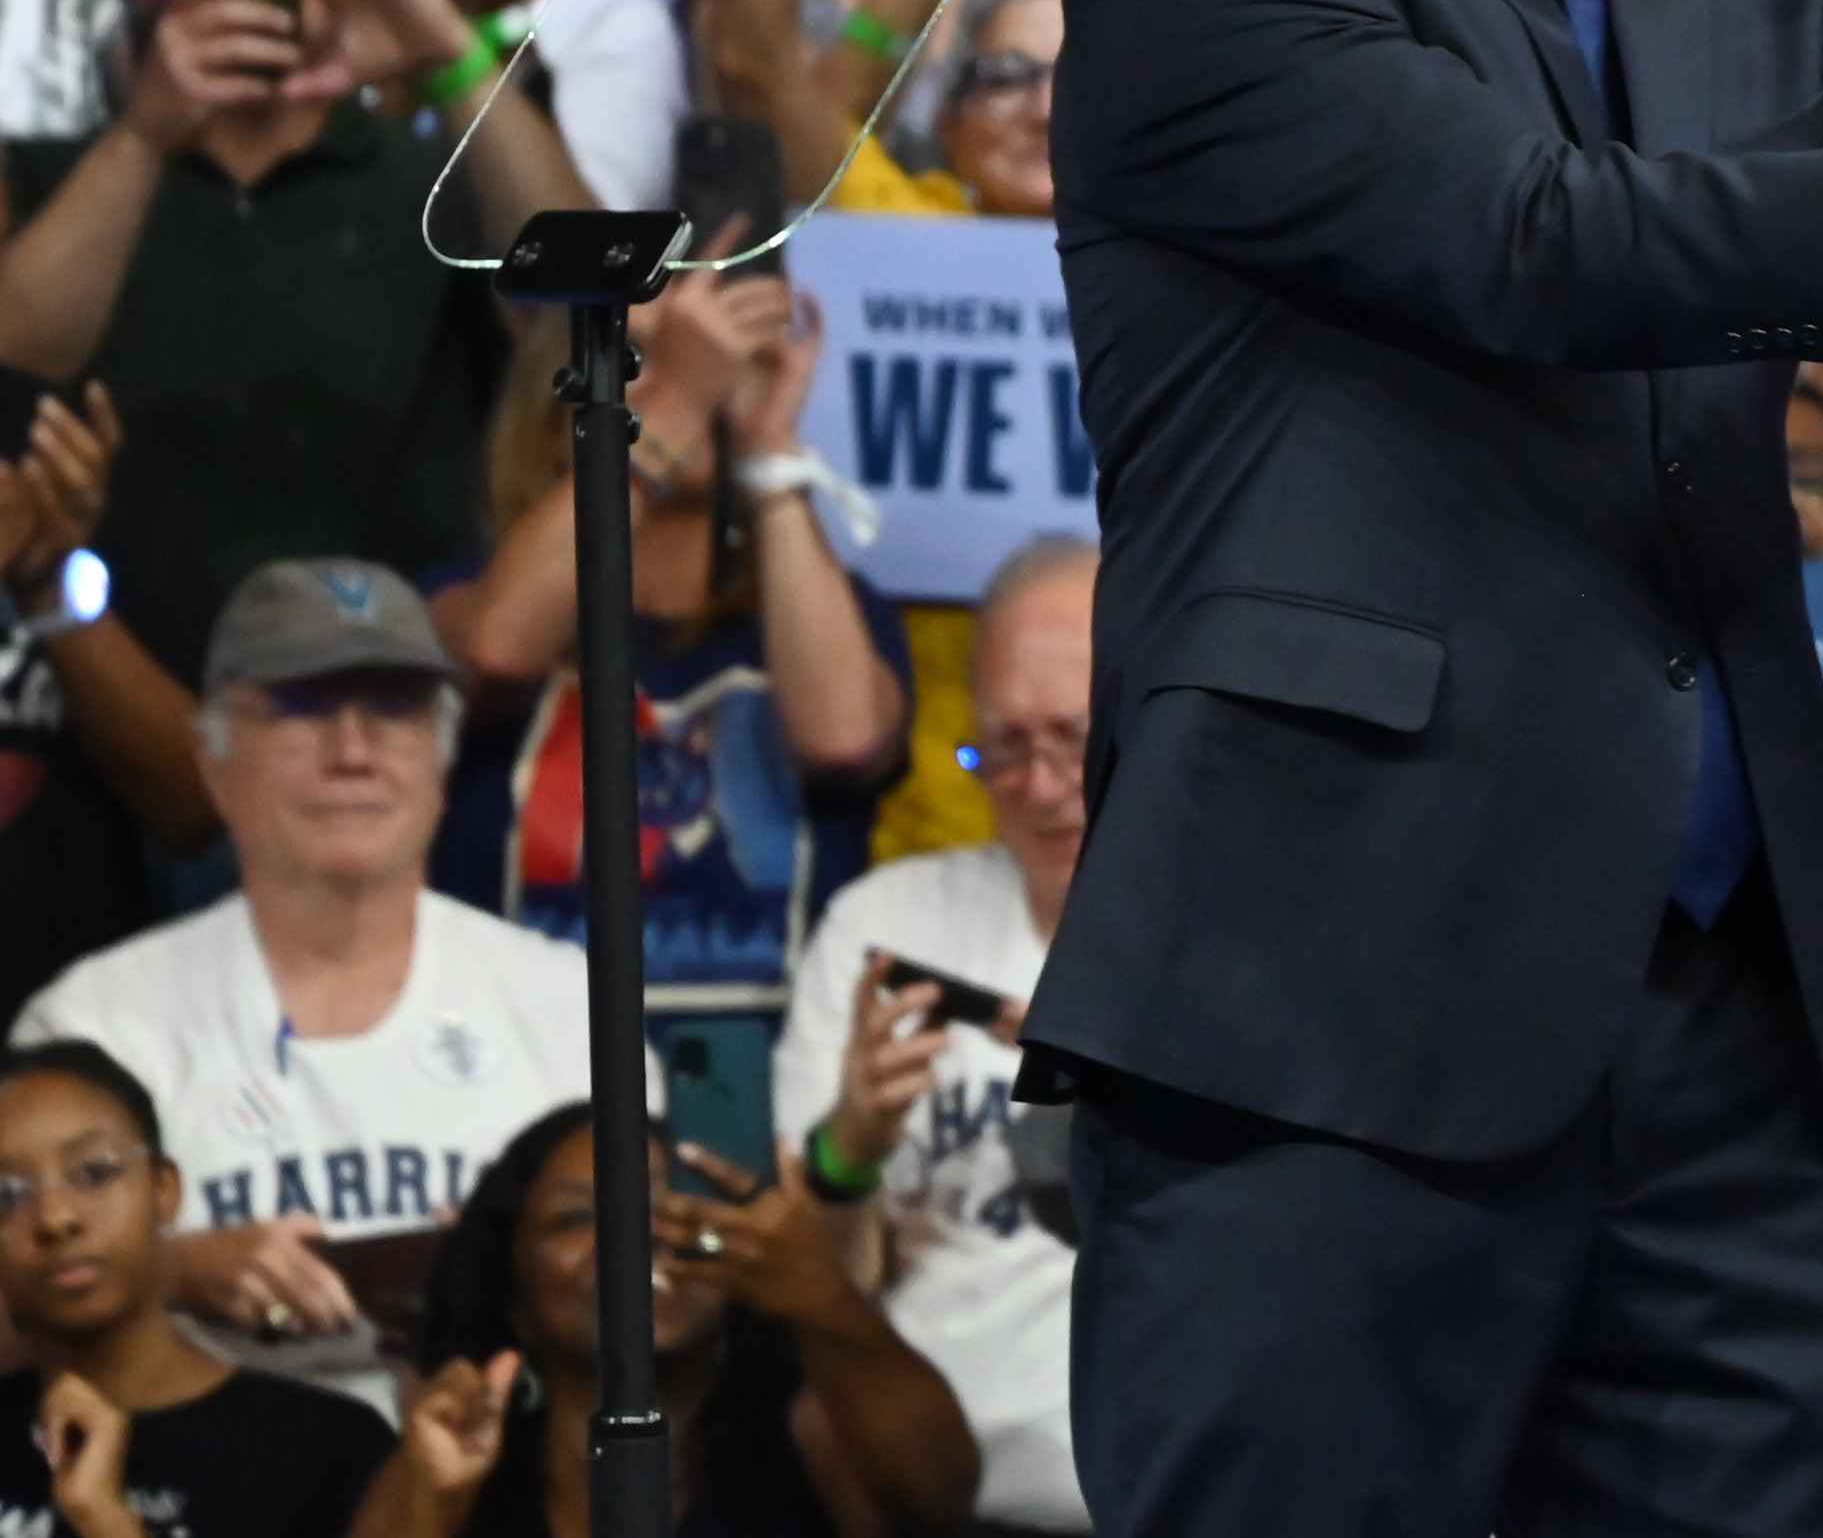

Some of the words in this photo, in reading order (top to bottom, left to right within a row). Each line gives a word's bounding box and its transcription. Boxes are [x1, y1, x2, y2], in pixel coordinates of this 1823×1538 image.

[862, 290, 1022, 336] WHEN
[849, 350, 1014, 494] WE
[202, 1144, 466, 1228] HARRI
